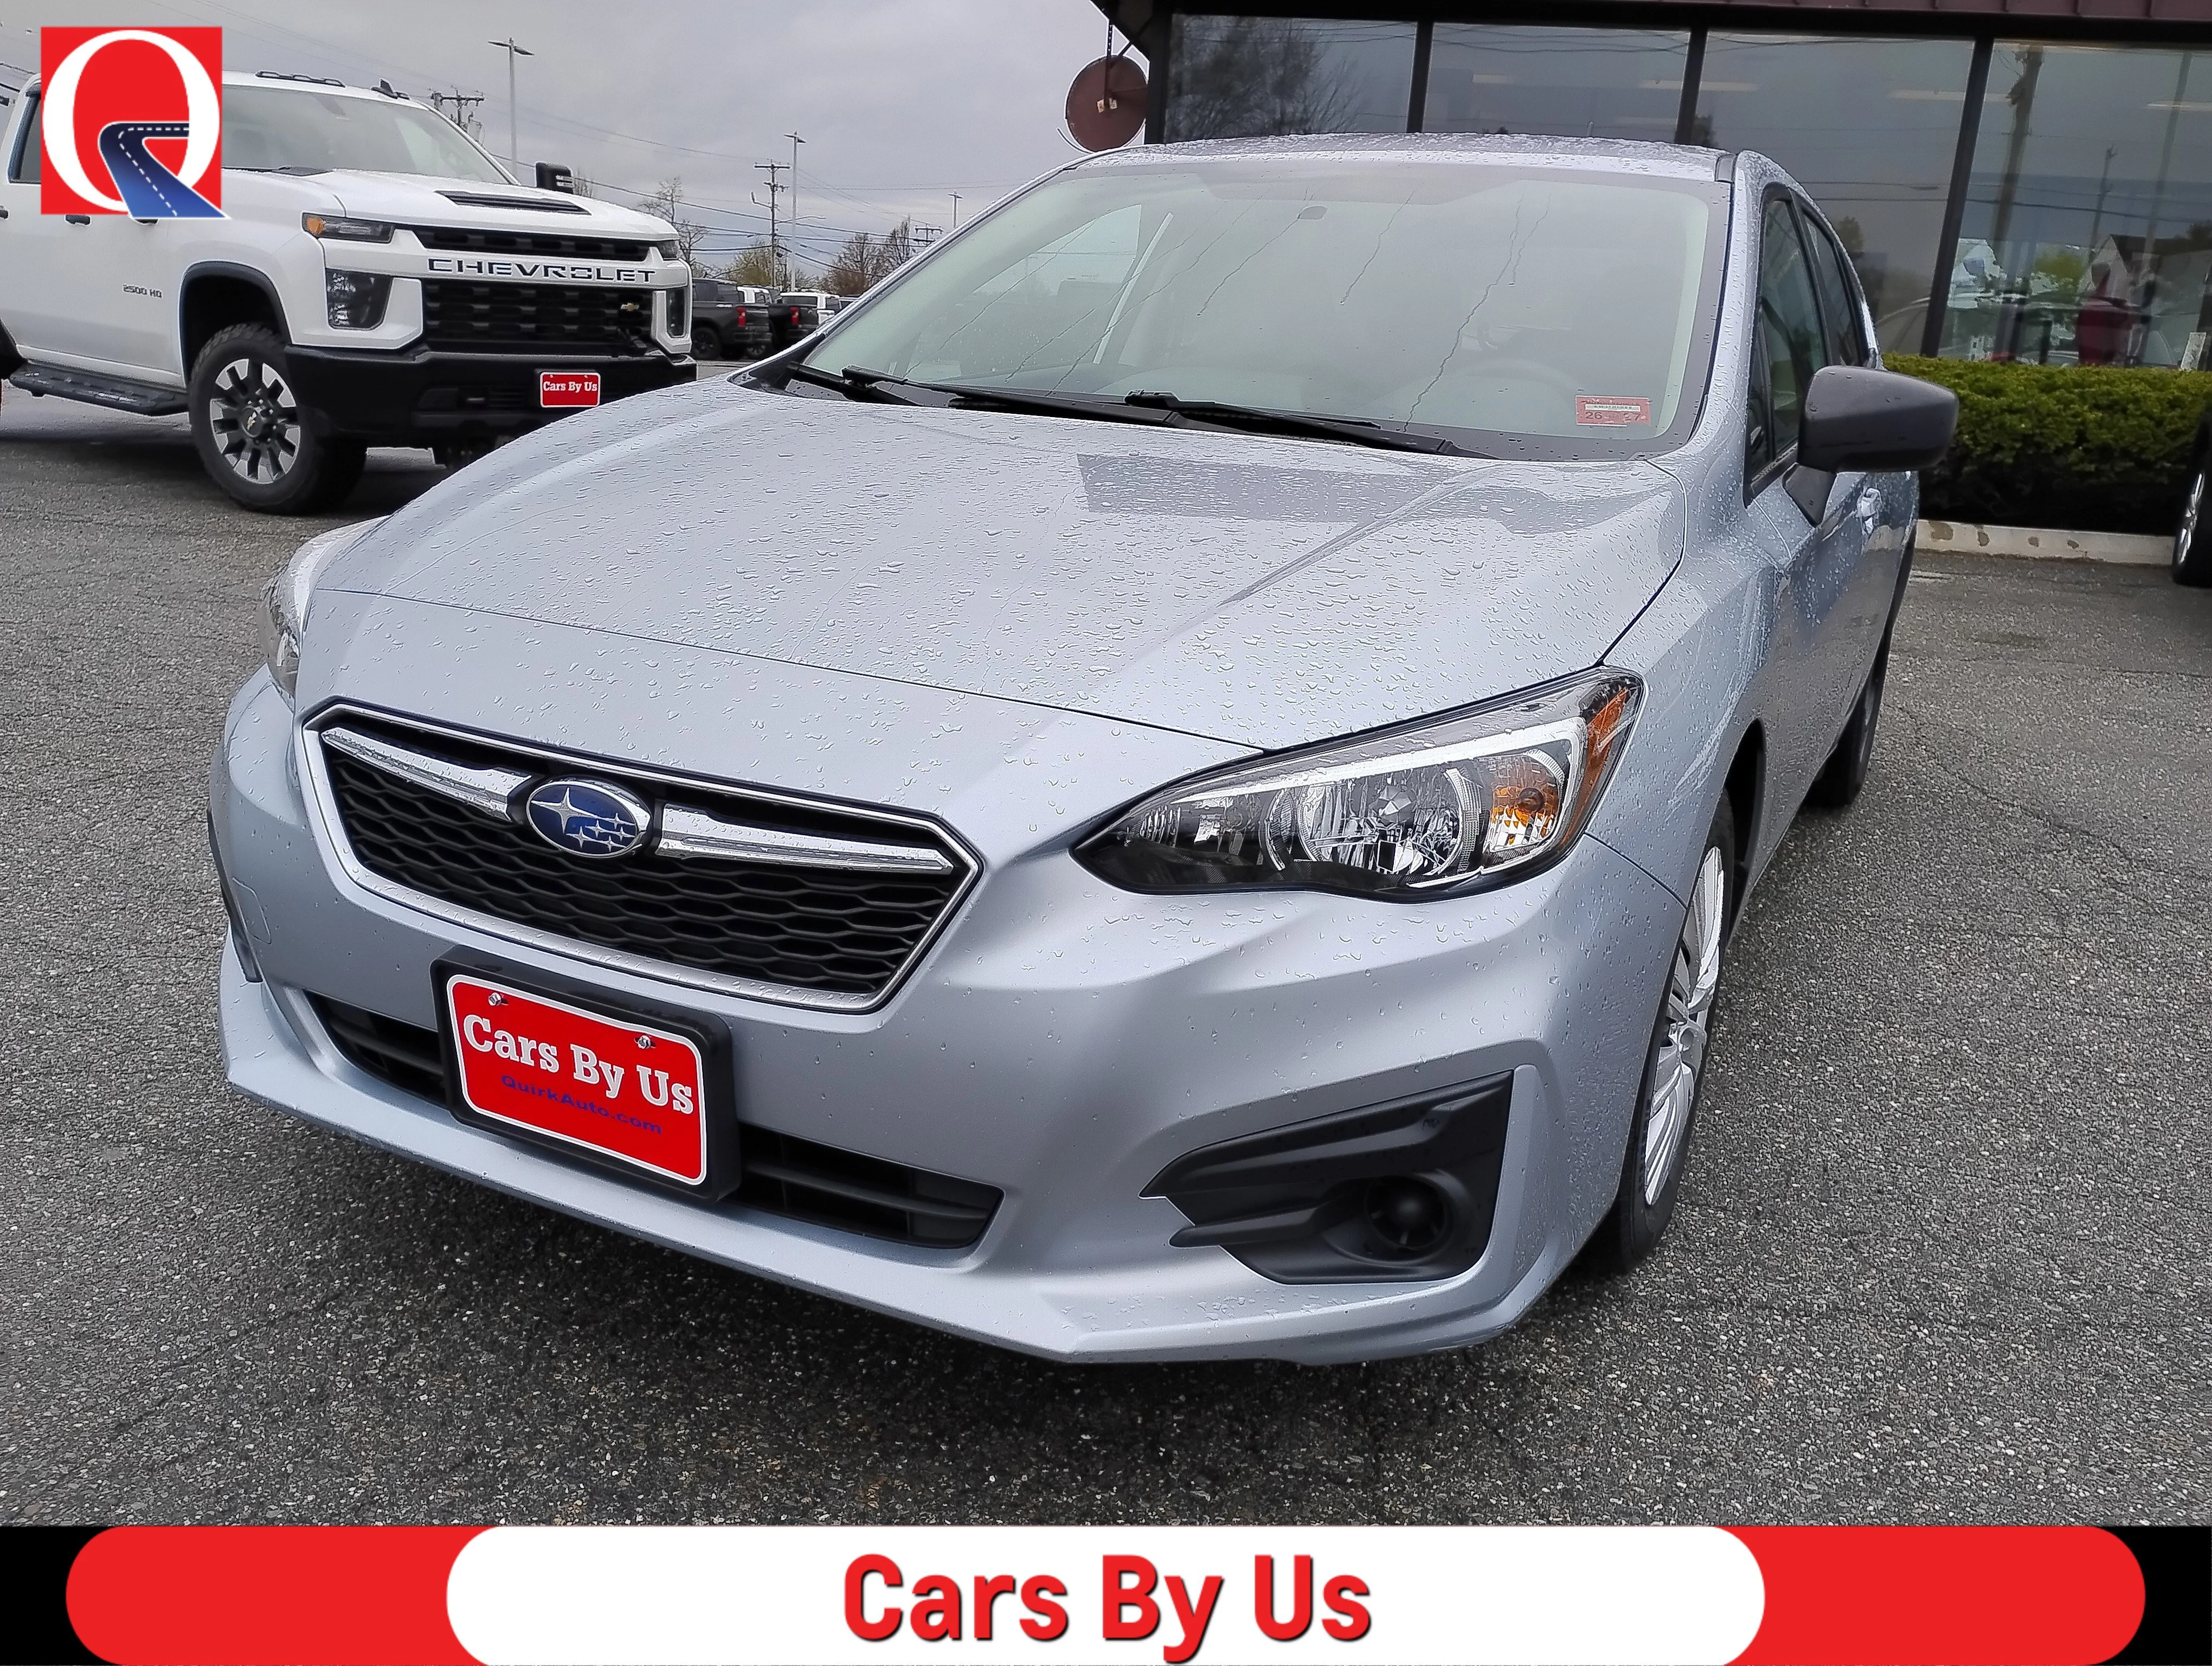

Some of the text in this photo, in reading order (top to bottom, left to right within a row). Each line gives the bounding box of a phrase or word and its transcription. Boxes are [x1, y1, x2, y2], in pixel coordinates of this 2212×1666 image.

[427, 258, 657, 283] CHEVROLET
[123, 284, 162, 298] 2500 HD
[543, 381, 597, 393] Cars By Us
[1585, 411, 1603, 420] 26
[463, 1014, 694, 1114] Cars By Us
[501, 1074, 663, 1135] QuirkAuto.com
